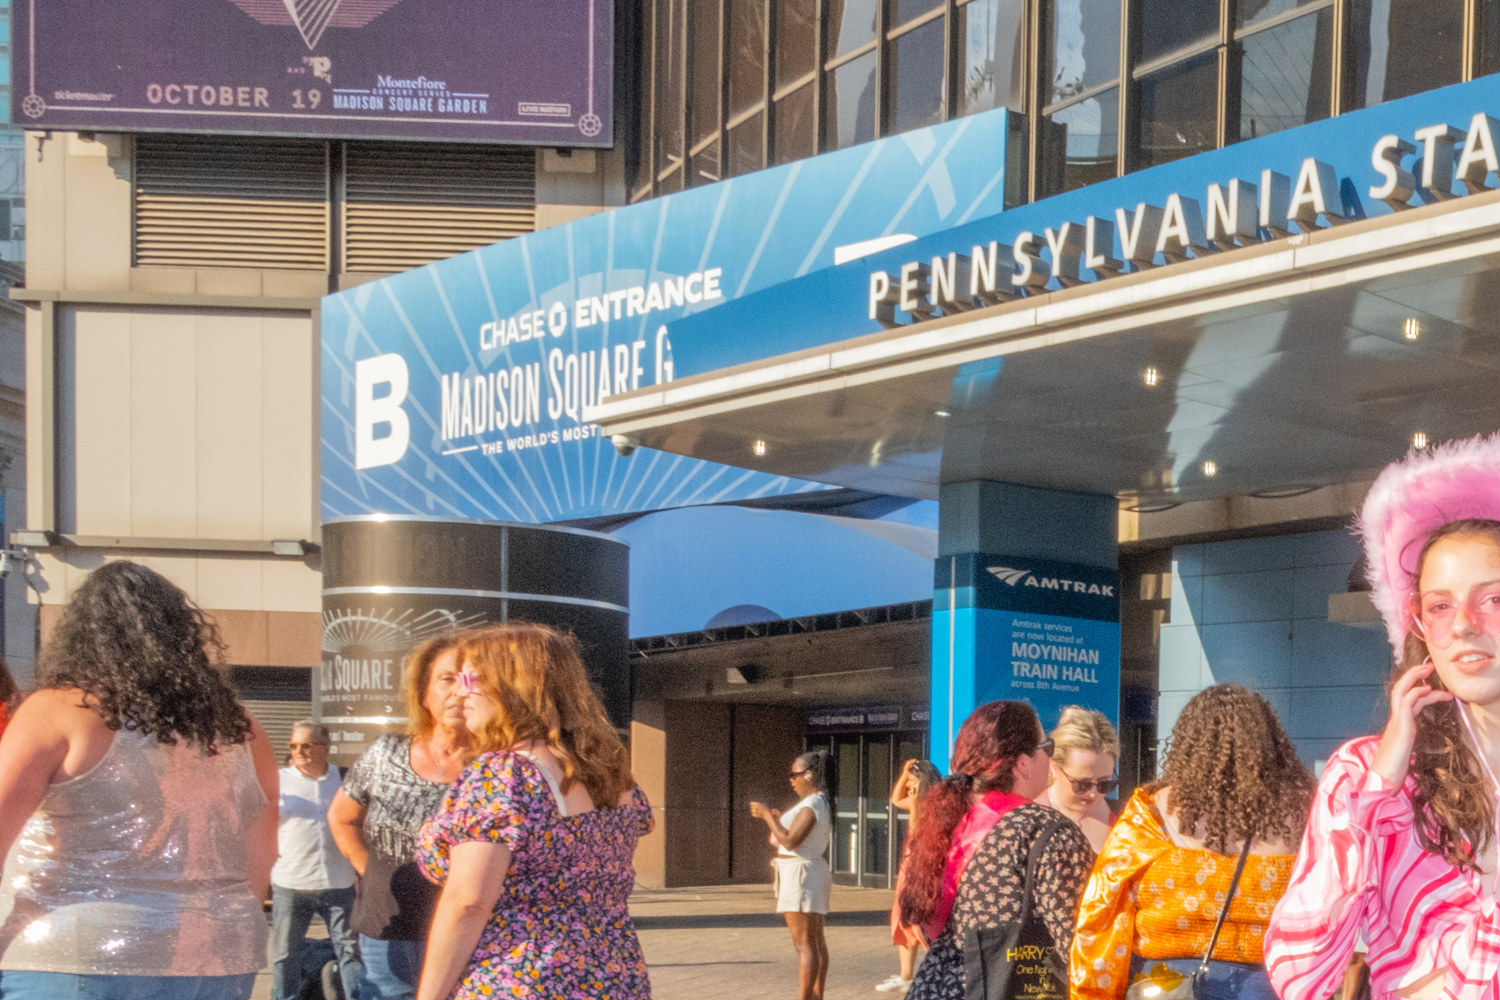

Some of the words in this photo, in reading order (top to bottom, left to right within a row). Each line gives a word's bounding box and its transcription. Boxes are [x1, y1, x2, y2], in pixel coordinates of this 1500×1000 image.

[377, 74, 447, 90] Montefiore
[146, 83, 270, 108] OCTOBER
[291, 89, 322, 109] 19
[333, 94, 384, 110] MADISON
[388, 96, 434, 113] SQUARE
[437, 98, 488, 113] GARDEN
[868, 157, 1330, 321] PENNSYLVANIA
[479, 309, 546, 352] CHASE
[574, 267, 723, 329] ENTRANCE
[354, 352, 411, 470] B
[481, 440, 503, 455] THE
[507, 431, 559, 452] WORLD'S
[562, 424, 599, 443] MOST
[1023, 575, 1115, 597] AMTRAK
[1012, 619, 1041, 630] Amtrak
[1043, 622, 1073, 633] services
[1012, 631, 1025, 639] are
[1027, 631, 1045, 641] now
[1045, 632, 1074, 644] located
[1011, 641, 1100, 665] MOYNIHAN
[334, 654, 393, 692] SQUARE
[1010, 660, 1058, 680] TRAIN
[1061, 665, 1099, 684] HALL
[1011, 681, 1034, 689] across
[1036, 681, 1049, 689] 8th
[1052, 684, 1079, 692] Avenue
[1006, 945, 1045, 962] HARRY
